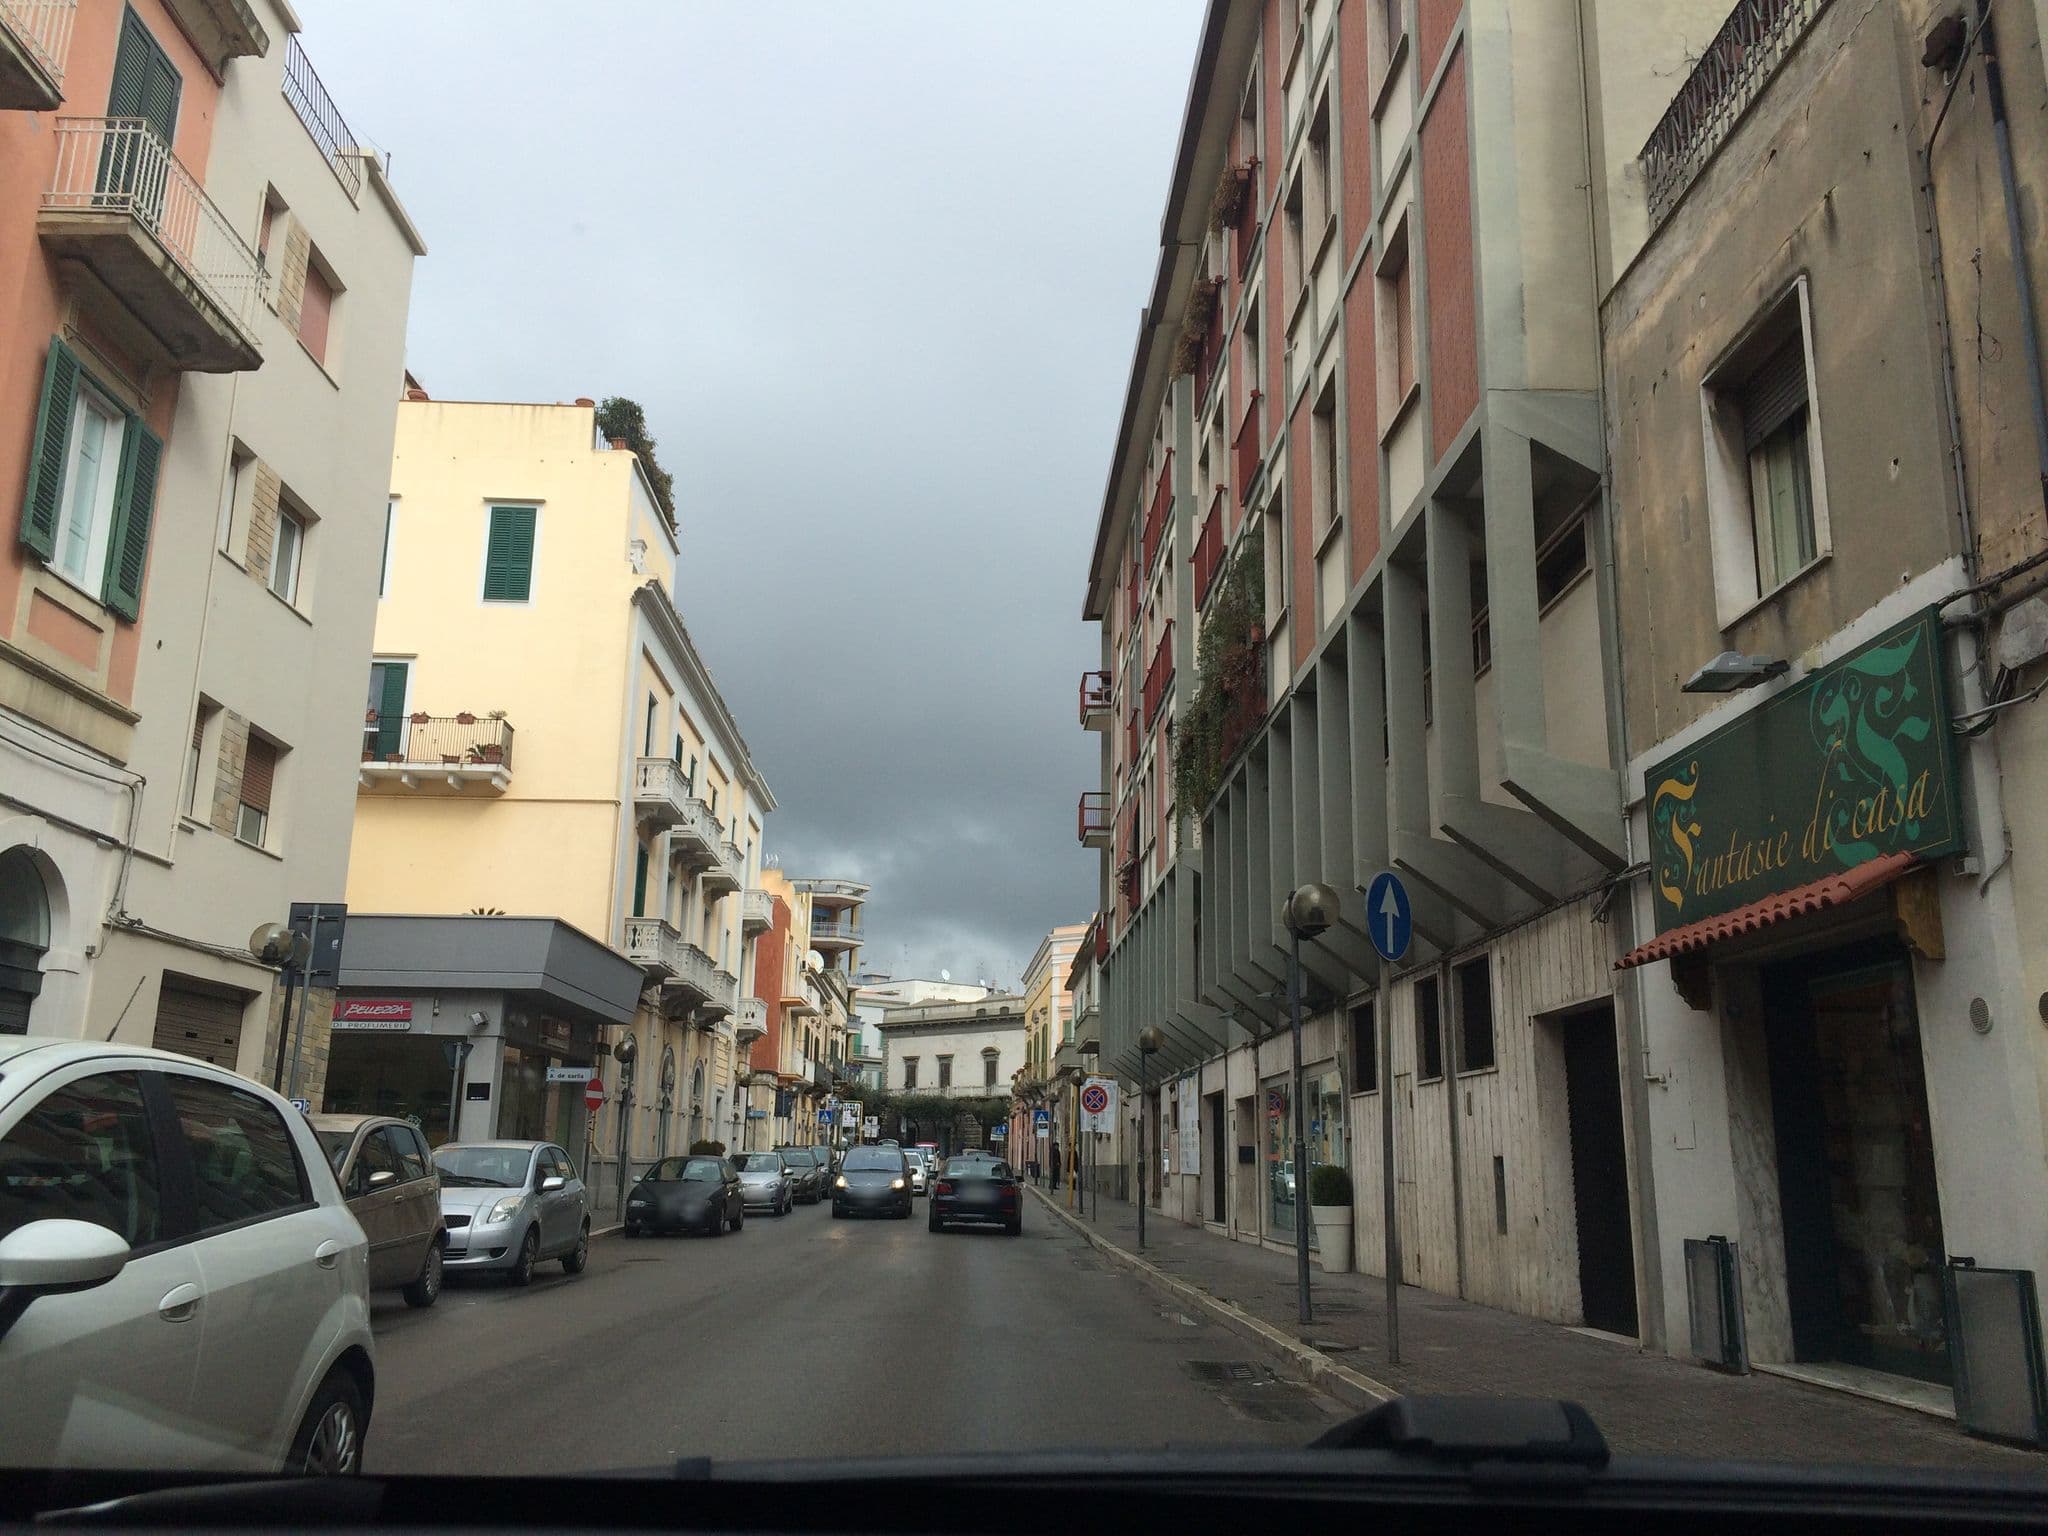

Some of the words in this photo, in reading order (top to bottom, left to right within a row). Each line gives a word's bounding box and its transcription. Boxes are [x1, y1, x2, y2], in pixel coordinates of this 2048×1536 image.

[1652, 760, 1793, 913] Fantasie
[1802, 739, 1843, 864] di
[1852, 768, 1942, 839] casa
[344, 1003, 411, 1017] BELLEZZA
